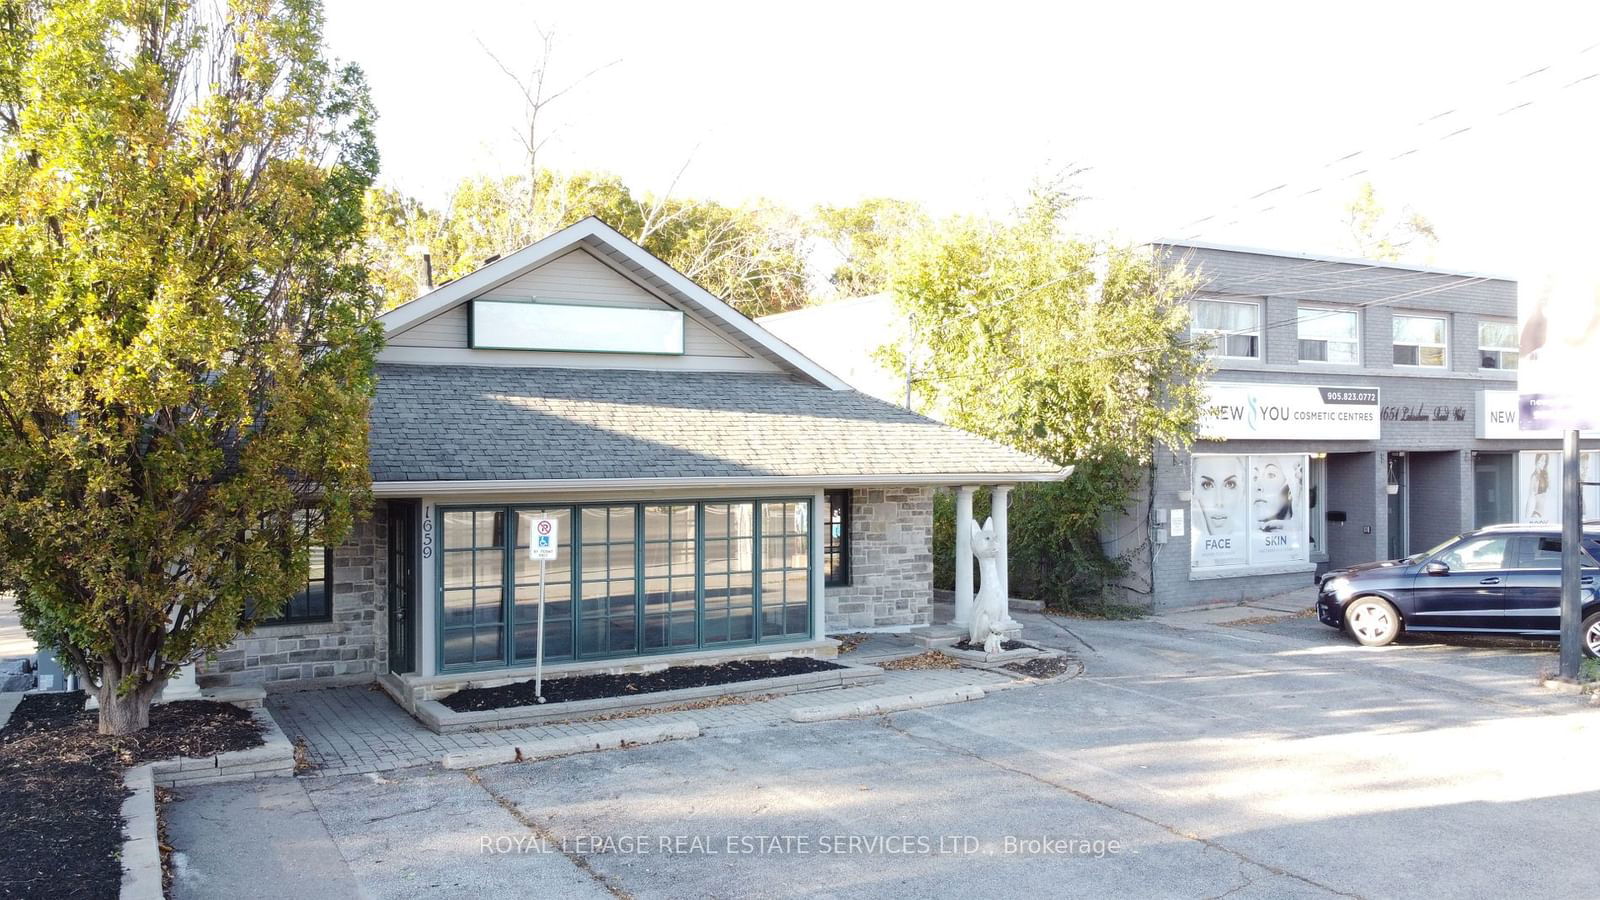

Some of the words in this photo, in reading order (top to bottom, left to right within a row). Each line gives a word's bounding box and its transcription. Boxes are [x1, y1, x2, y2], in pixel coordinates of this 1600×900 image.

[1327, 392, 1376, 401] 905.823.0772
[1260, 406, 1290, 421] YOU
[1294, 411, 1335, 420] COSMETIC
[1338, 412, 1374, 421] CENTRES
[1490, 411, 1516, 423] NEW
[423, 506, 432, 559] 1659
[1205, 538, 1231, 550] FACE
[1265, 535, 1287, 547] SKIN
